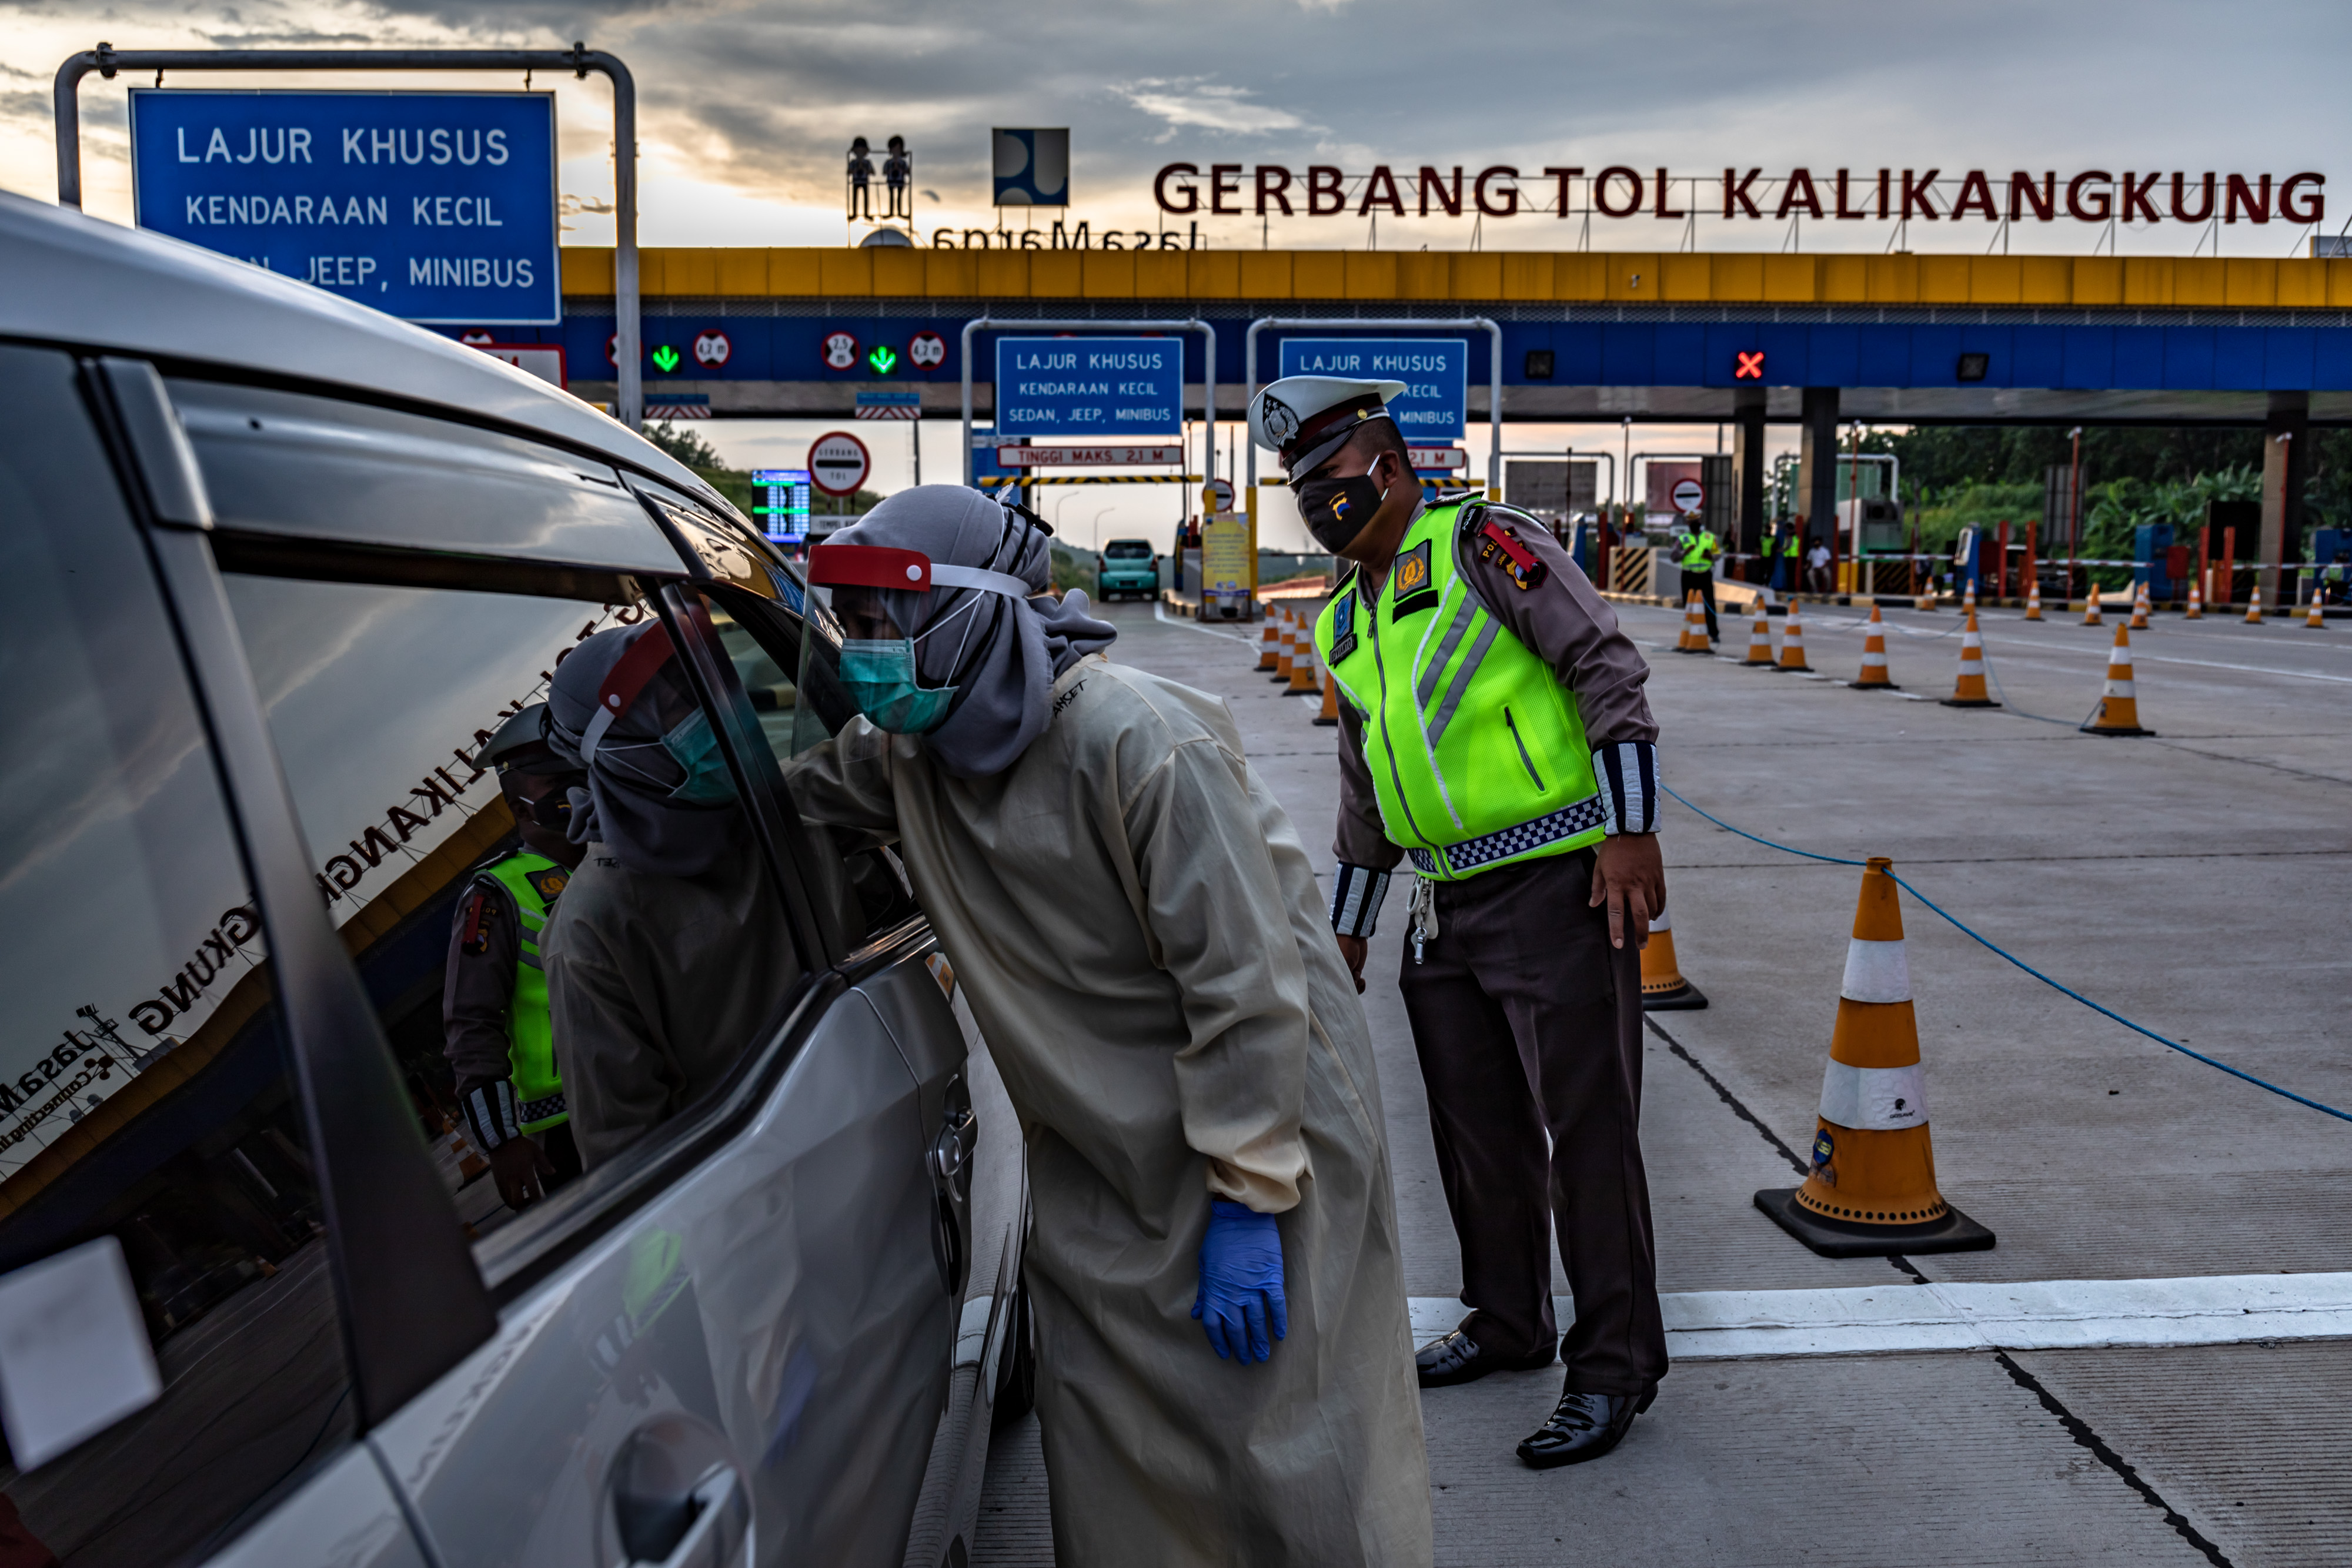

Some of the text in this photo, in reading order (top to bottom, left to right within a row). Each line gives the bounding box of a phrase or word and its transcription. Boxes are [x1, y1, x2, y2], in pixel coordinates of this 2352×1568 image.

[177, 126, 510, 166] LAJUR KHUSUS
[1154, 162, 2326, 223] GERBANG TOL KALIKANGKUNG
[186, 195, 503, 226] KENDARAAN KECIL
[299, 256, 534, 292] JEEP, MINIBUS
[717, 344, 727, 355] m
[932, 346, 941, 355] m
[837, 355, 846, 364] m
[1017, 353, 1162, 370] LAJUR KHUSUS
[1300, 355, 1446, 372] LAJUR KHUSUS
[1020, 383, 1158, 396] KENDARAAN KECIL
[1402, 385, 1442, 398] KECIL
[1009, 408, 1171, 424] SEDAN, JEEP, MINIBUS
[1399, 411, 1455, 424] MINIBUS
[1018, 450, 1063, 463] TINGGI
[1152, 450, 1164, 462] M
[1434, 452, 1445, 464] M
